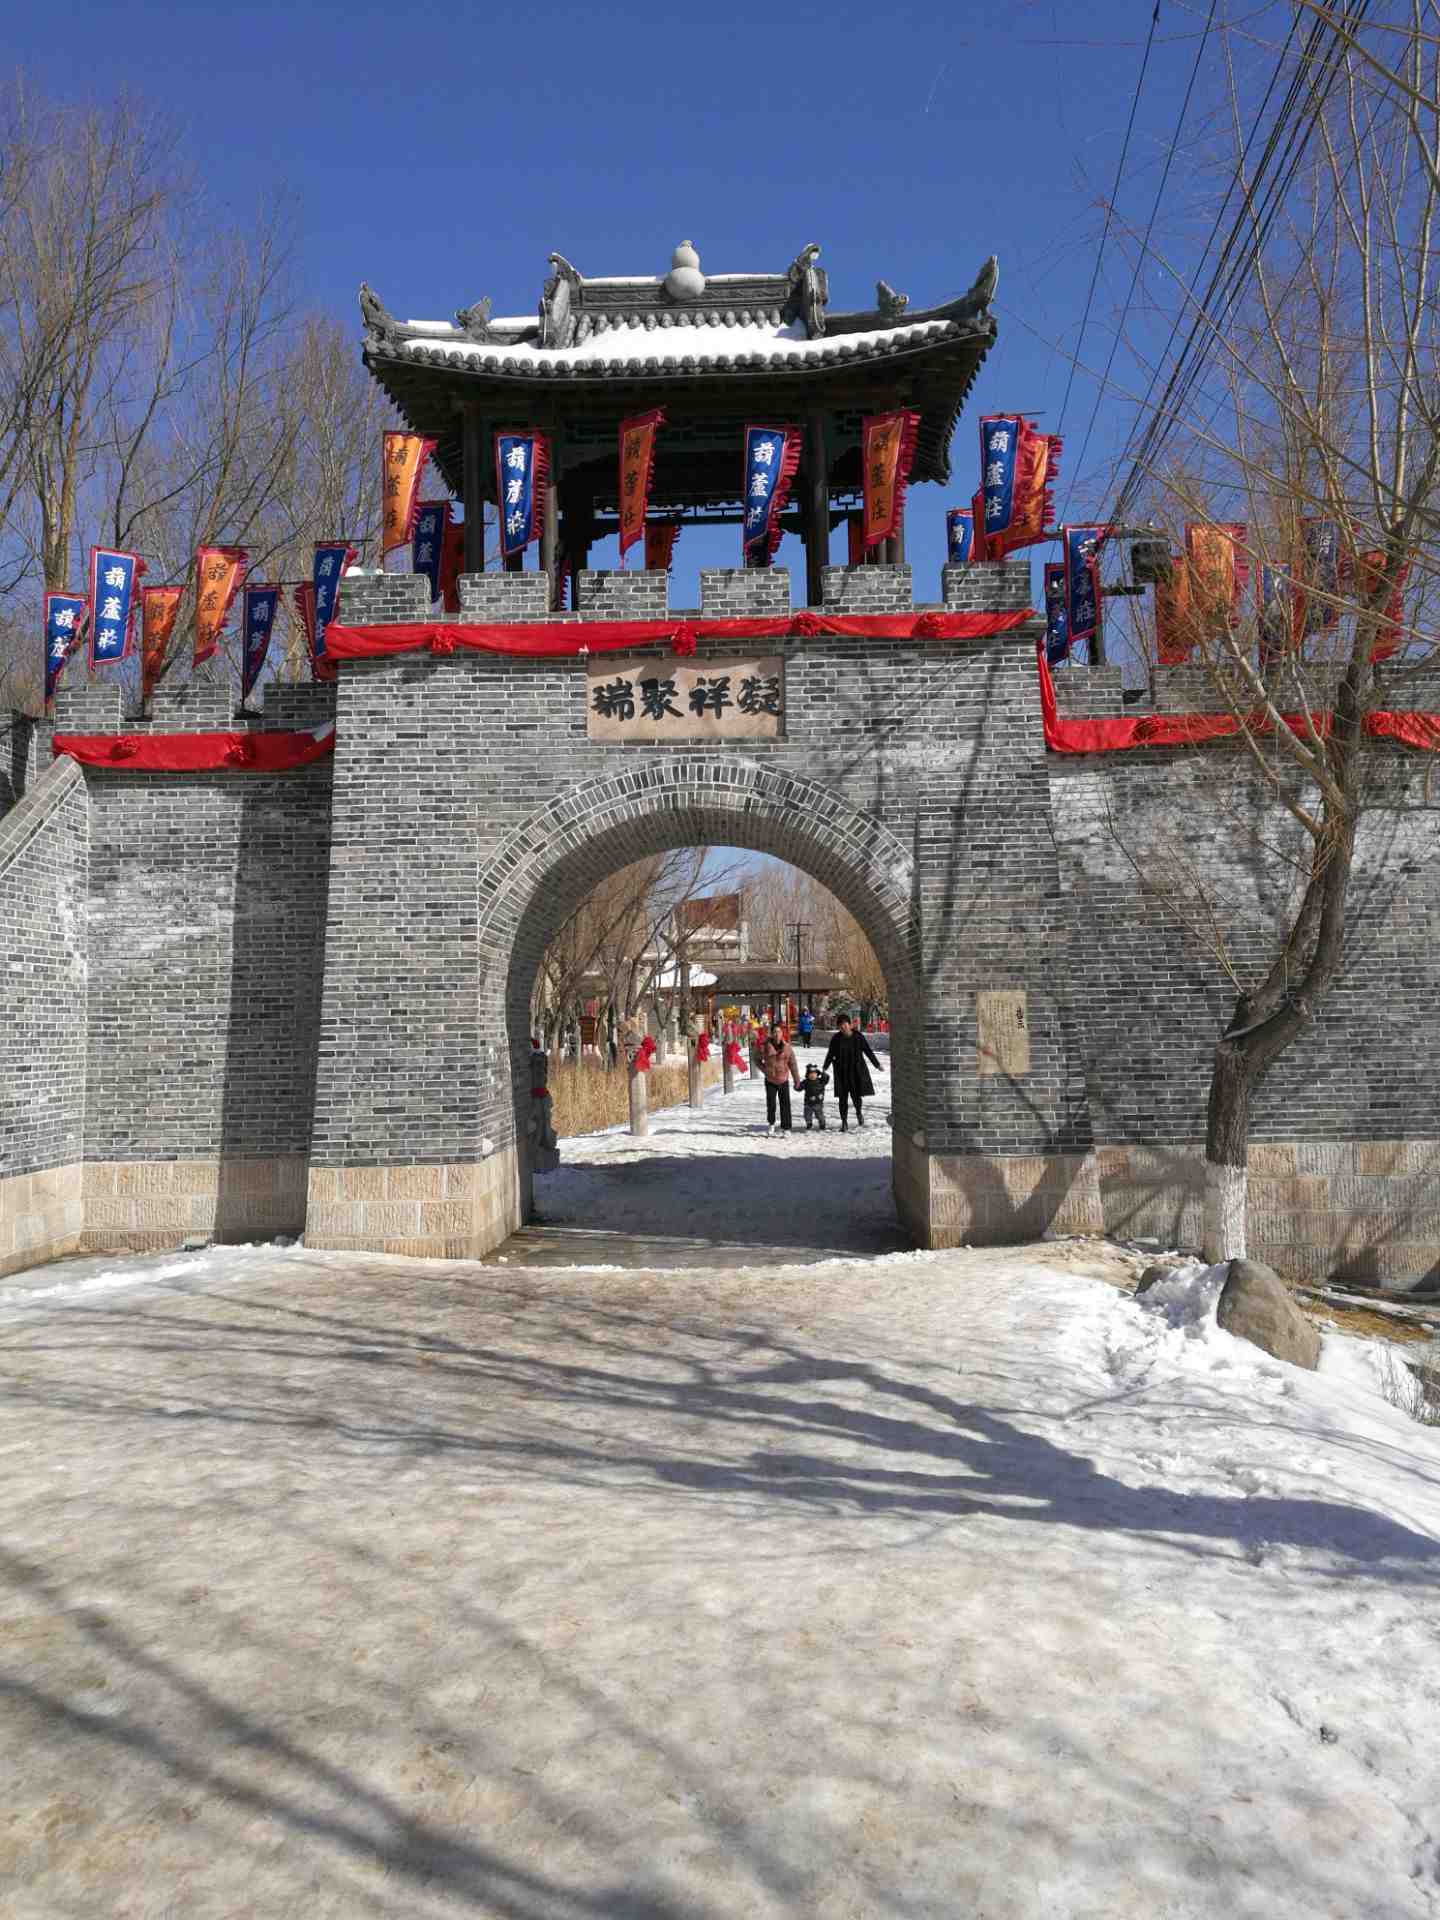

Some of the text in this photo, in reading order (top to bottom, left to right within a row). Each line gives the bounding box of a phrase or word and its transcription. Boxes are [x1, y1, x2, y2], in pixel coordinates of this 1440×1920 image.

[506, 446, 525, 535] 葫蘆莊
[746, 442, 775, 529] 葫蘆莊
[985, 430, 1010, 519] 葫蘆莊
[97, 567, 126, 649] 葫蘆莊
